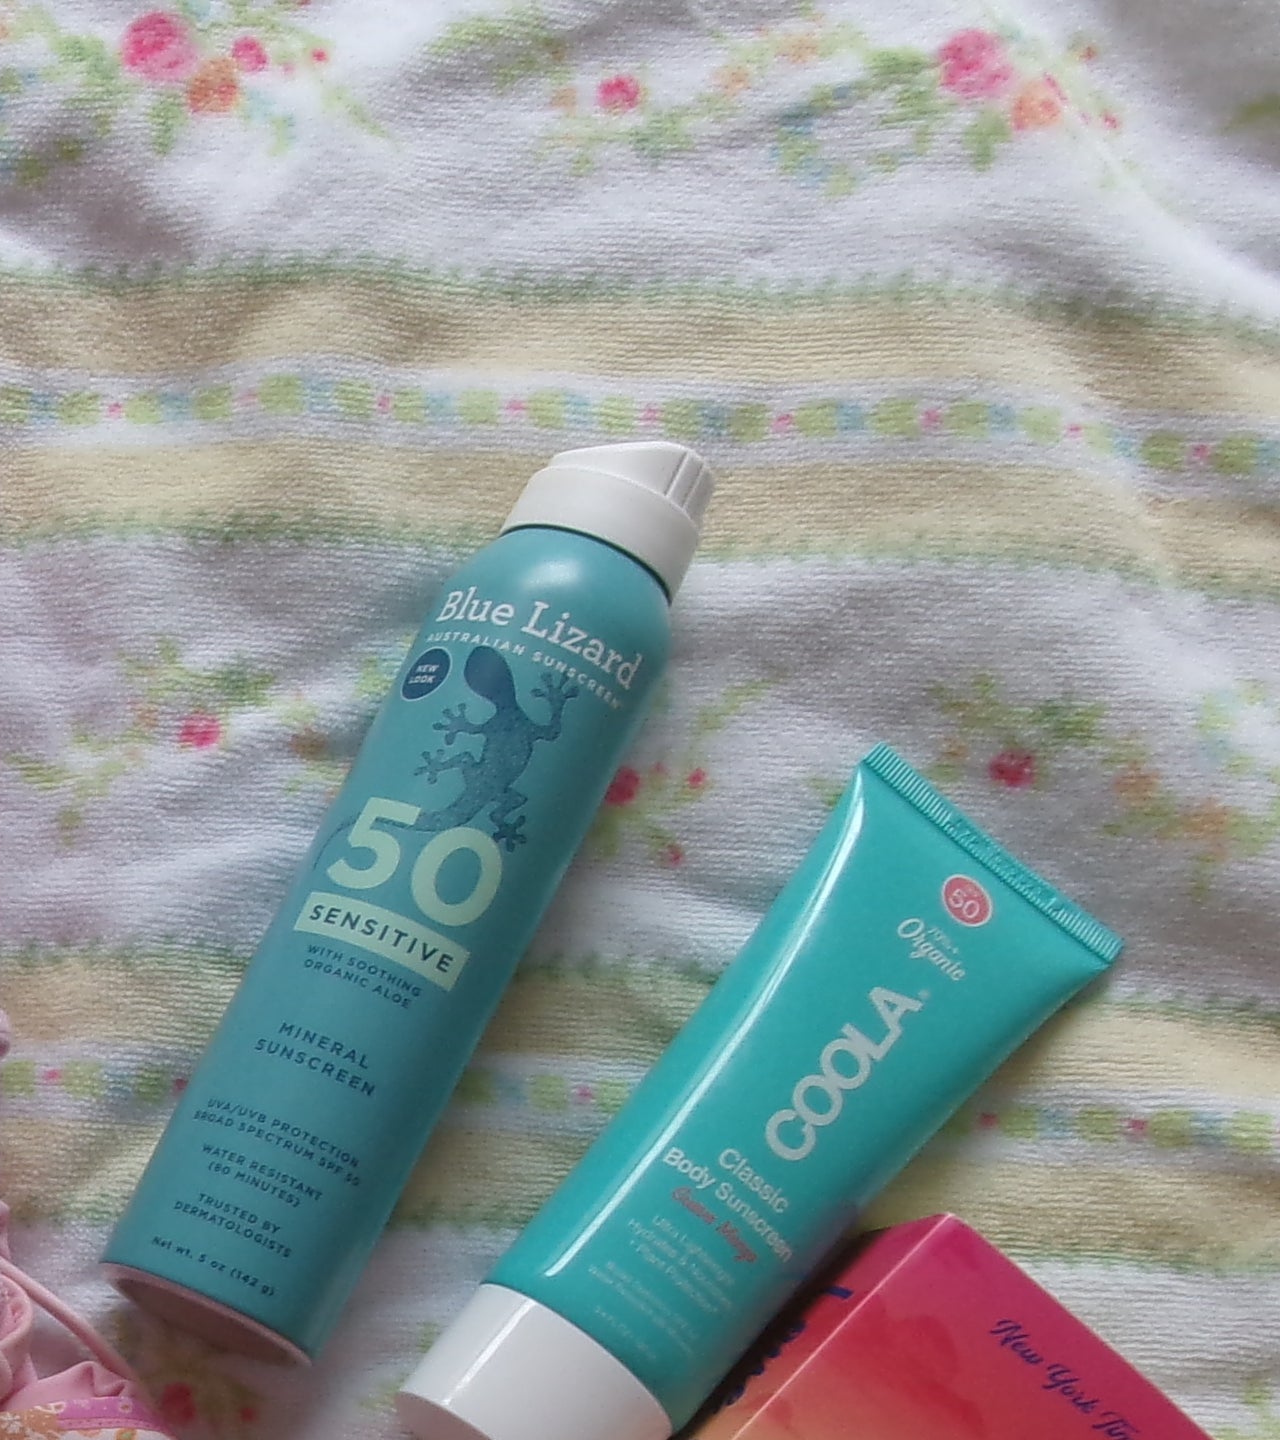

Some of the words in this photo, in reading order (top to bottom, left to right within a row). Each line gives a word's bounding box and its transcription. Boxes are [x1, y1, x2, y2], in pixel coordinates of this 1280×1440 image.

[435, 586, 515, 626] Blue
[520, 601, 643, 690] Lizard
[408, 675, 436, 684] LOOK
[415, 664, 439, 673] NEW
[426, 631, 526, 656] AUSTRALIAN
[532, 651, 622, 709] SUNSCREEN
[326, 797, 502, 927] 50
[948, 888, 980, 919] 50
[309, 905, 454, 973] SENSITIVE
[897, 918, 966, 981] Organic
[303, 958, 369, 988] ORGANIC
[372, 984, 410, 1009] ALOE
[307, 944, 344, 963] WITH
[346, 957, 423, 997] SOOTHING
[254, 1038, 376, 1097] SUNSCREEN
[277, 1021, 371, 1070] MINERAL
[765, 986, 925, 1161] COOLA
[193, 1110, 234, 1128] BROAD
[237, 1122, 315, 1161] SPECTRUM
[317, 1157, 344, 1175] SPF
[207, 1098, 267, 1123] UVA/UVB
[270, 1118, 360, 1168] PROTECTION
[202, 1142, 246, 1166] WATER
[248, 1159, 323, 1201] RESISTANT
[207, 1160, 231, 1175] (80
[234, 1171, 301, 1208] MINUTES)
[718, 1148, 789, 1213] Classic
[173, 1200, 292, 1258] DERMATOLOGISTS
[198, 1193, 258, 1224] TRUSTED
[262, 1220, 281, 1234] BY
[662, 1146, 716, 1190] Body
[715, 1182, 793, 1263] Sunscreen
[197, 1254, 207, 1263] 5
[210, 1260, 226, 1272] oz
[230, 1268, 259, 1287] (142
[990, 1319, 1044, 1365] New
[1042, 1363, 1100, 1414] York
